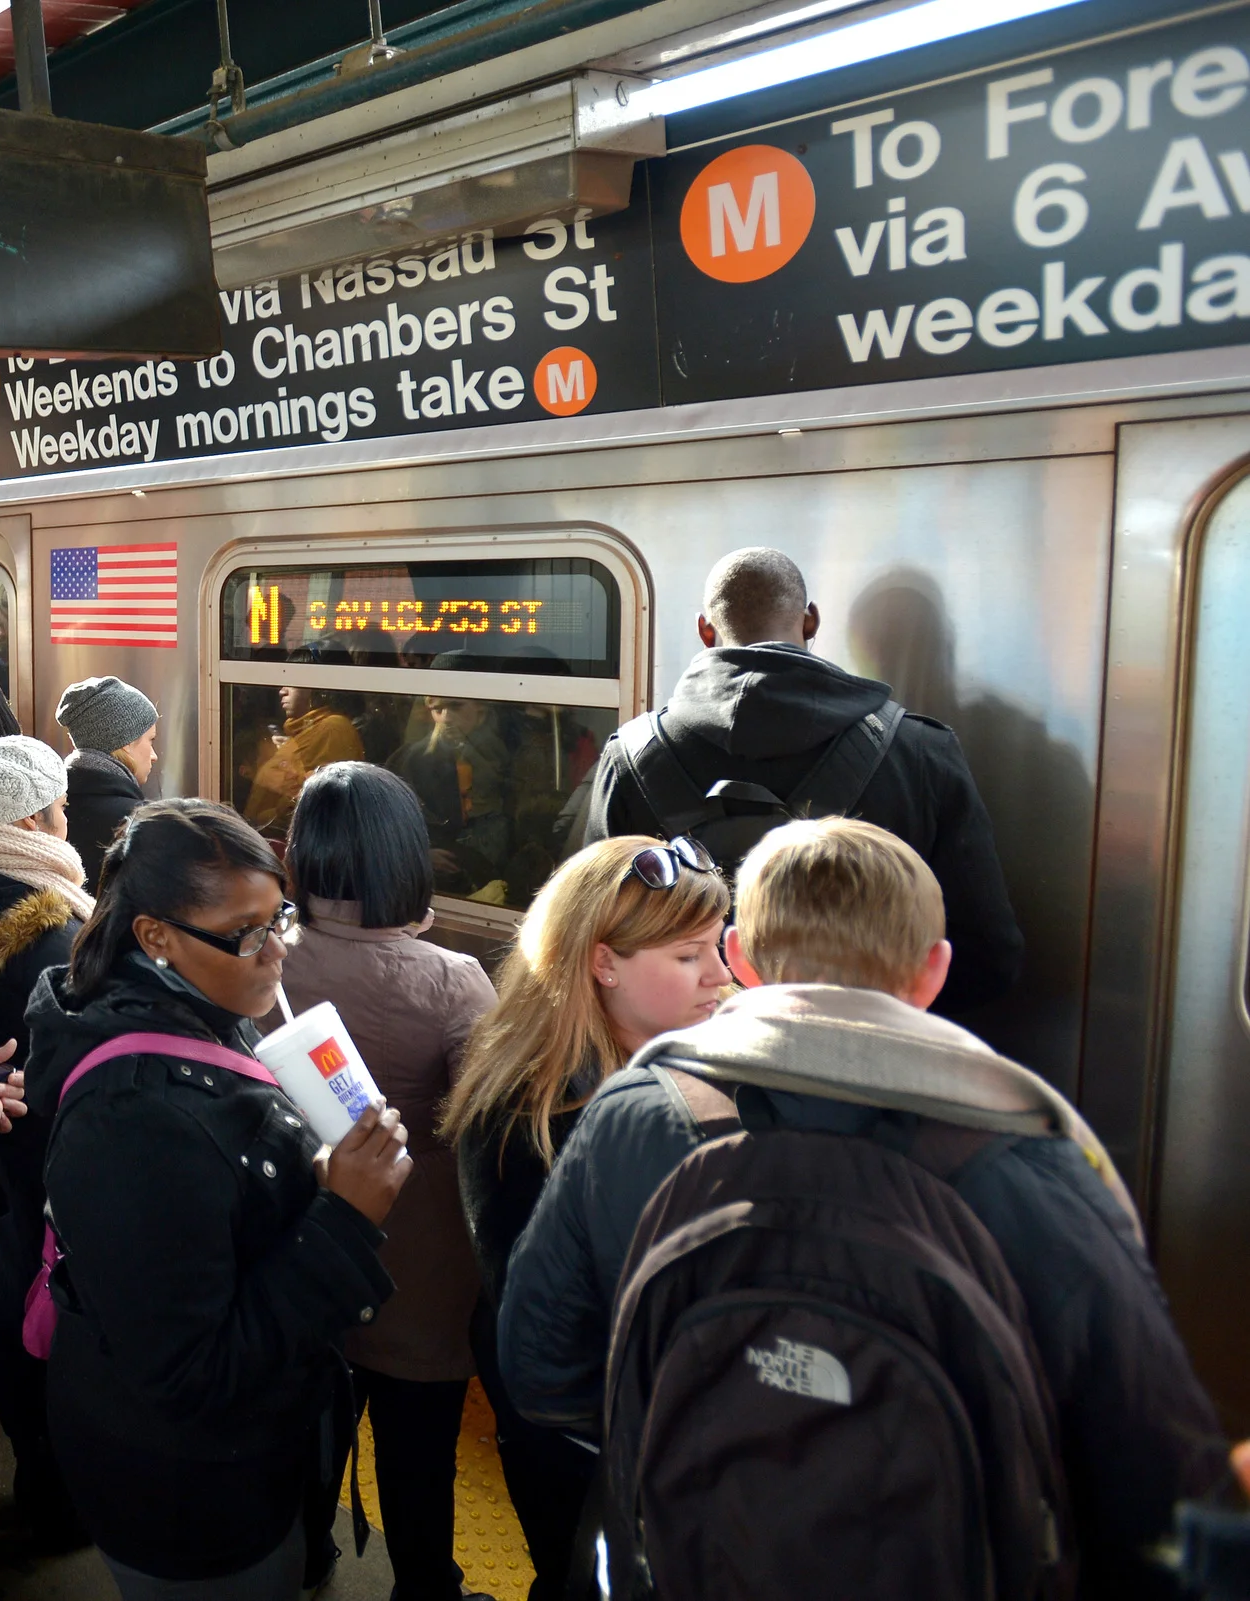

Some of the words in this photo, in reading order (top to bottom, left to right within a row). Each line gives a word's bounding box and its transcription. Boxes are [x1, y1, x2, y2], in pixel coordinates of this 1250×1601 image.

[831, 107, 941, 189] To
[986, 45, 1250, 160] Fore
[707, 171, 782, 258] M
[834, 196, 967, 278] via
[1014, 163, 1090, 249] 6
[4, 360, 179, 421] Weekends
[194, 350, 235, 388] to
[252, 295, 516, 379] Chambers
[544, 264, 617, 331] St
[219, 279, 282, 325] via
[838, 242, 1250, 363] weekda
[10, 414, 160, 469] Weekday
[176, 388, 377, 448] mornings
[398, 359, 525, 420] take
[547, 360, 586, 406] M
[328, 1073, 350, 1095] GET
[747, 1346, 811, 1381] NORTH
[758, 1368, 812, 1397] FACE
[776, 1338, 814, 1361] THE
